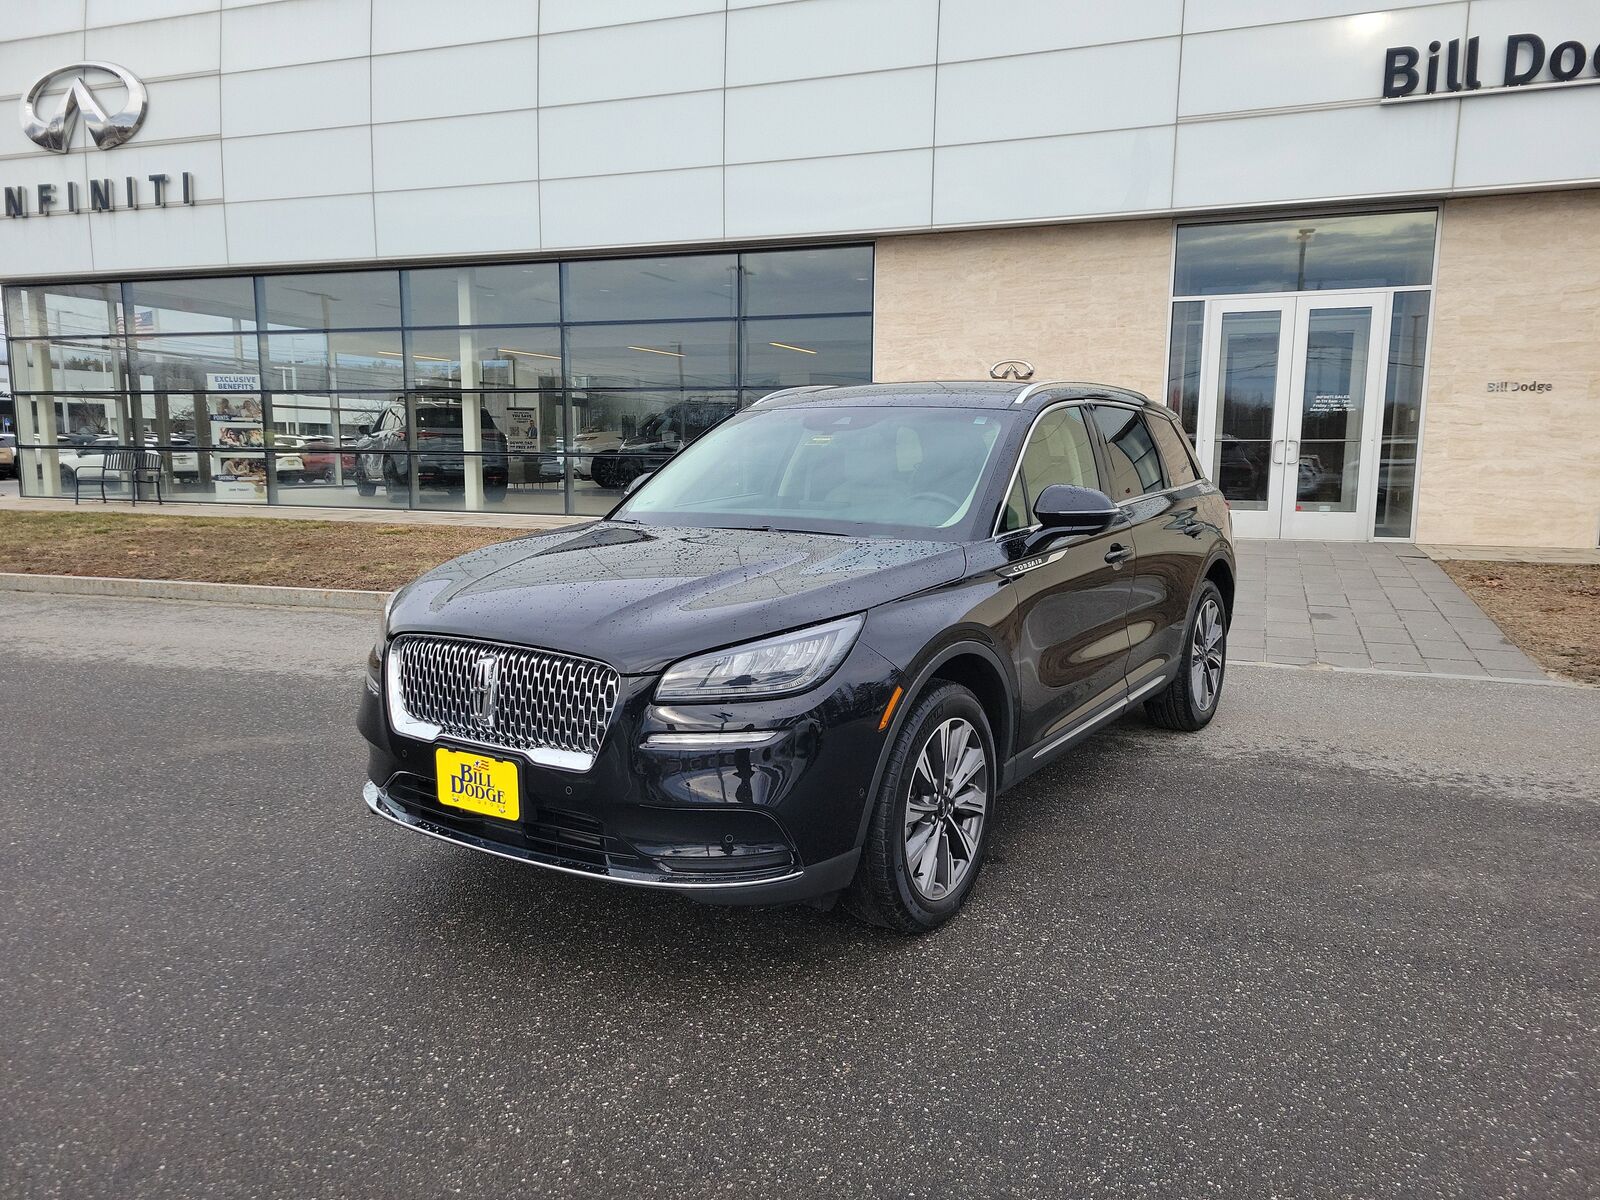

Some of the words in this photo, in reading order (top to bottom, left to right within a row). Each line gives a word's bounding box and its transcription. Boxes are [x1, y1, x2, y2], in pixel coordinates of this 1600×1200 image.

[1383, 35, 1481, 98] Bill
[1503, 33, 1600, 87] Do
[4, 172, 196, 218] NFINITI
[1487, 381, 1508, 392] Bill
[1511, 380, 1552, 394] Dodge
[1013, 558, 1043, 572] CORSAIR
[460, 763, 495, 788] BILL
[451, 775, 506, 804] DODGE
